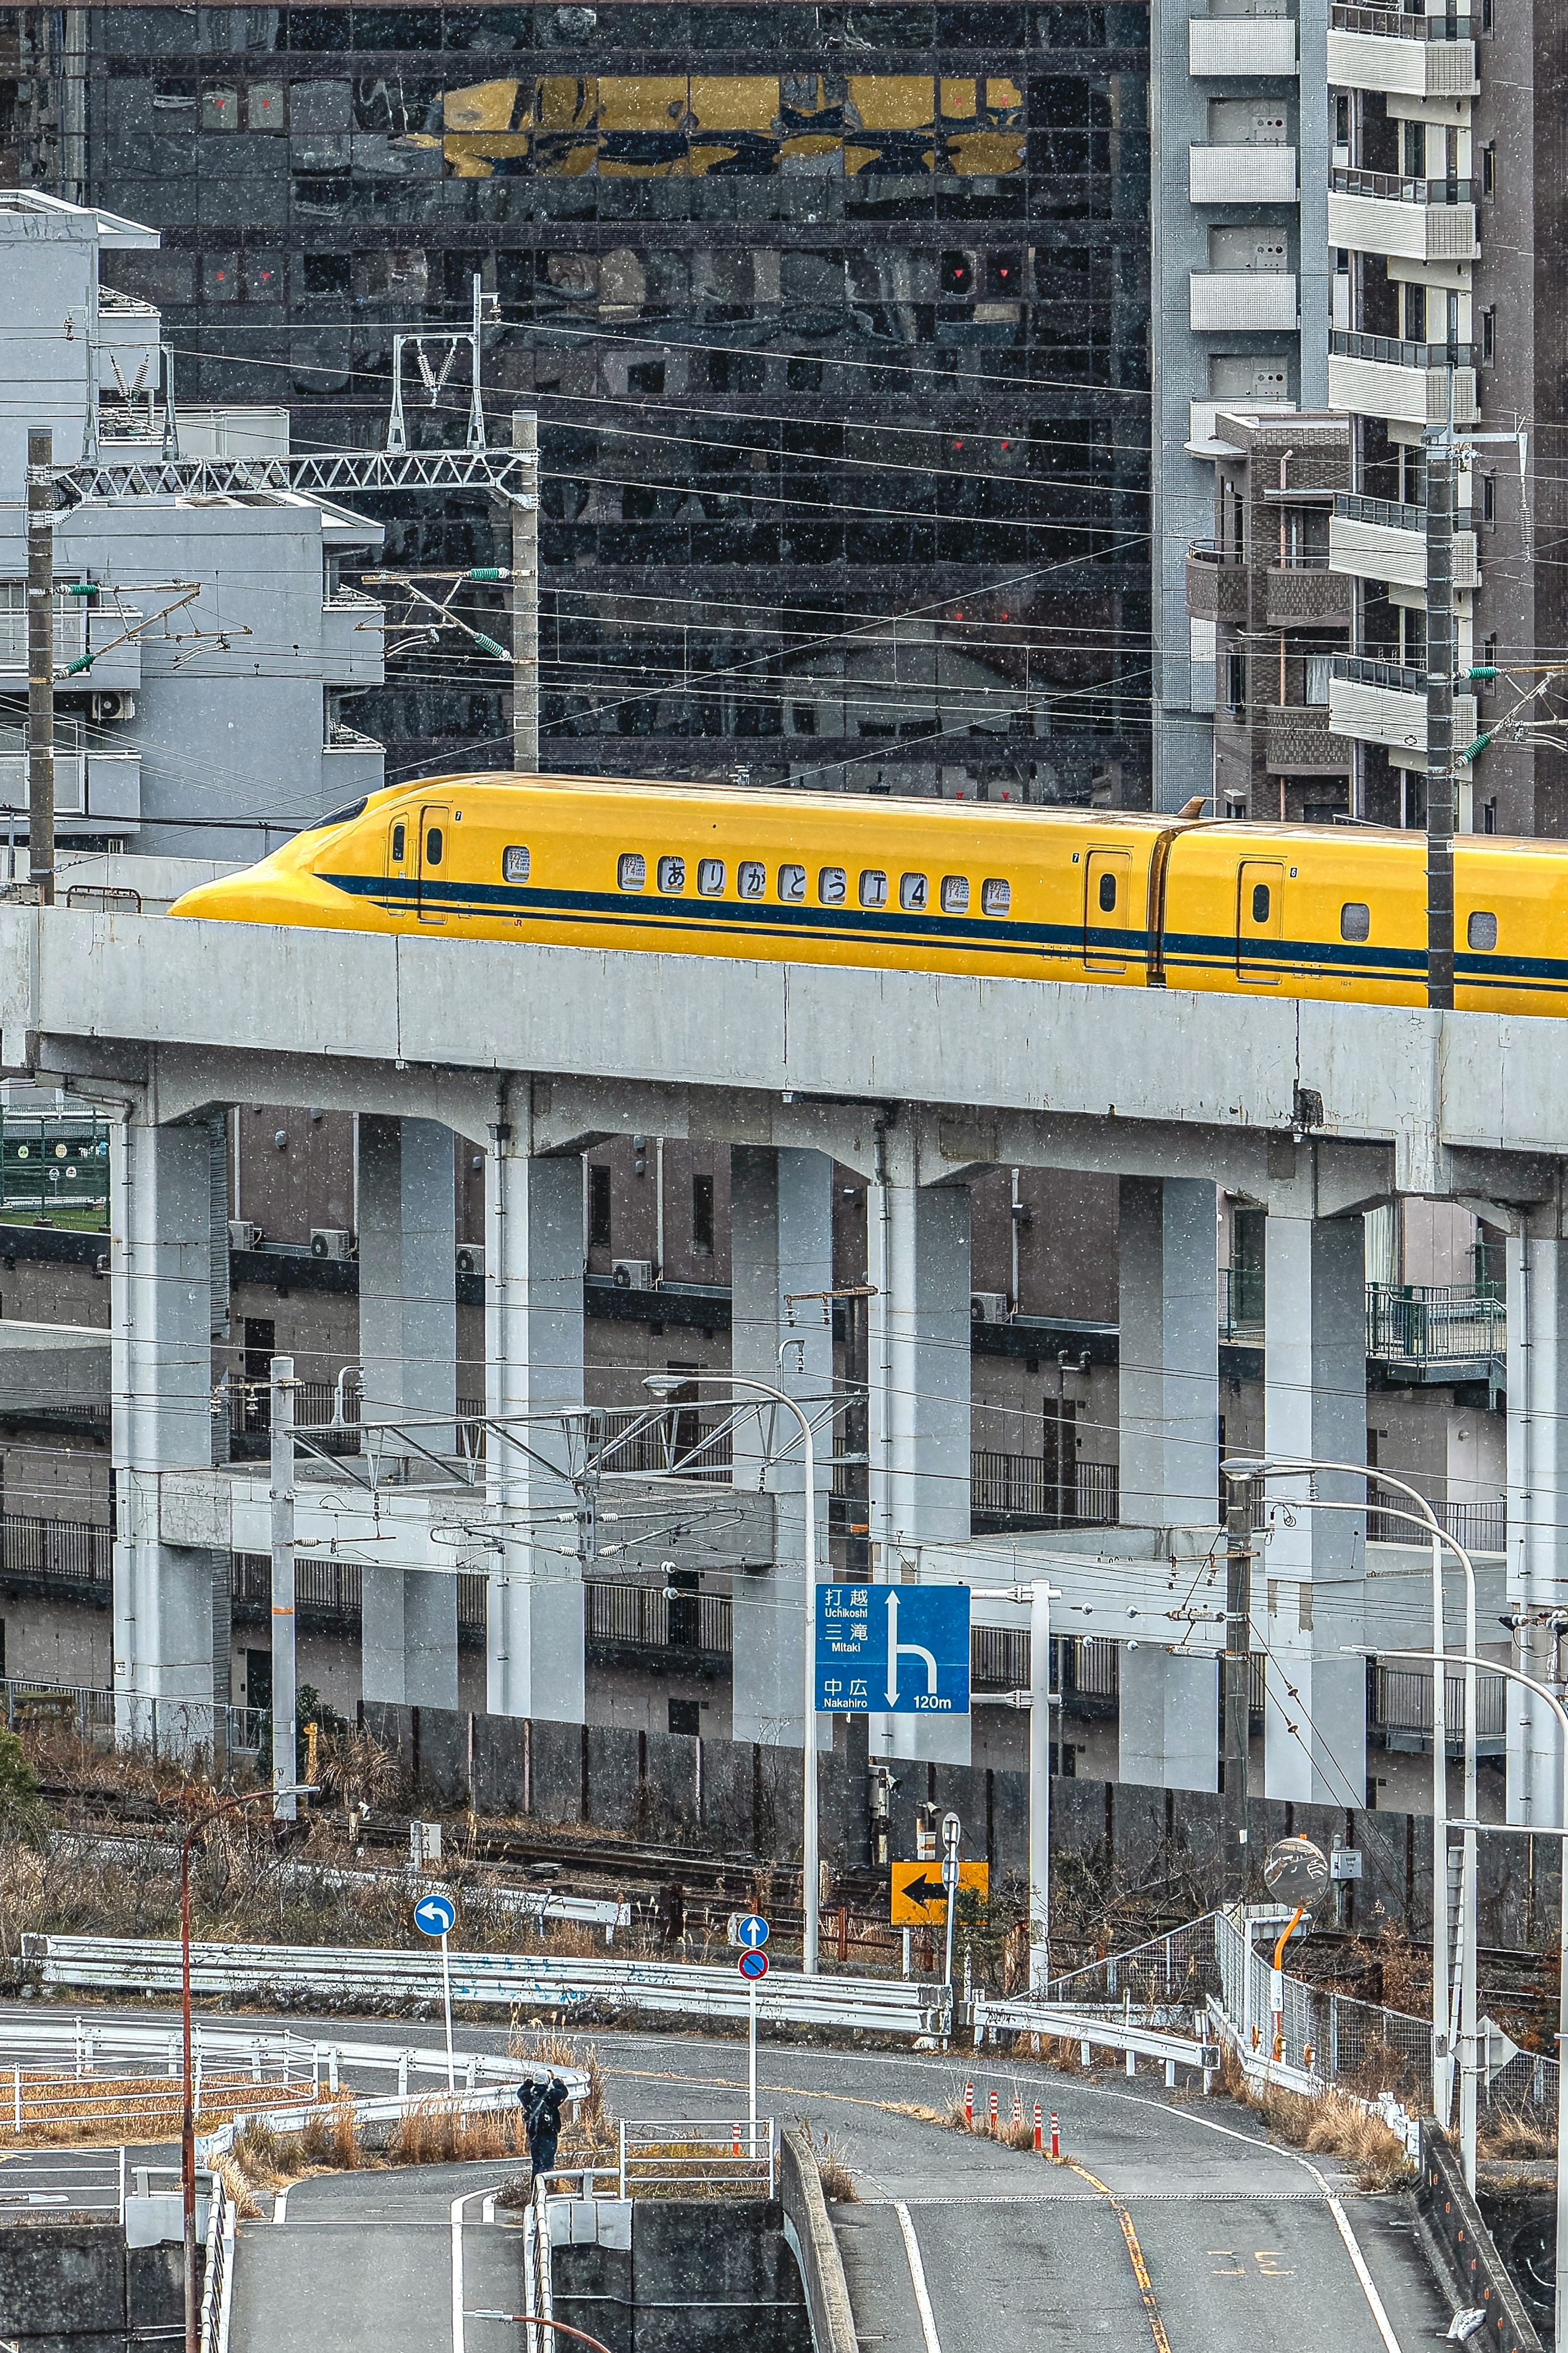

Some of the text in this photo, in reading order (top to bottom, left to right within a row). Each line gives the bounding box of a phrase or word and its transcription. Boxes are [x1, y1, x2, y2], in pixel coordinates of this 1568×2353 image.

[1291, 868, 1296, 877] 6
[949, 879, 960, 888] 923
[825, 1589, 868, 1607] 打越
[825, 1608, 868, 1618] Uchikoshi
[825, 1623, 868, 1641] 三滝
[832, 1642, 861, 1652] Mitaki
[824, 1678, 868, 1696] 中広
[824, 1698, 868, 1708] Nakahiro
[913, 1696, 952, 1709] 120m
